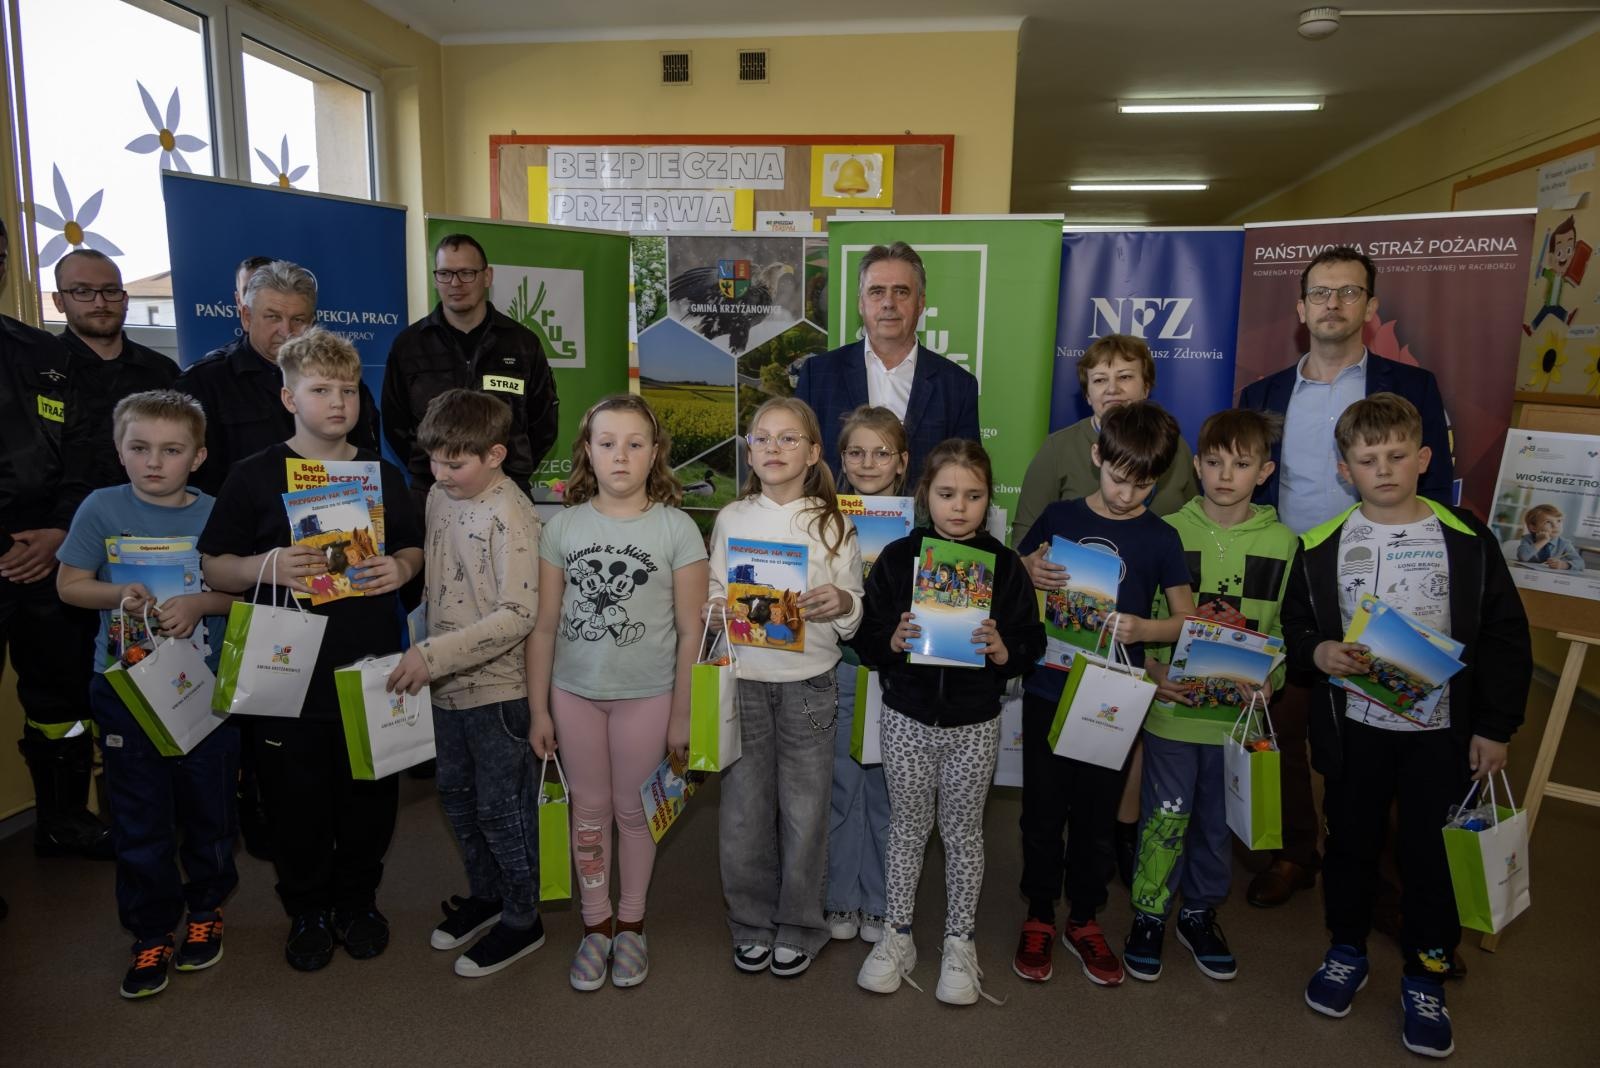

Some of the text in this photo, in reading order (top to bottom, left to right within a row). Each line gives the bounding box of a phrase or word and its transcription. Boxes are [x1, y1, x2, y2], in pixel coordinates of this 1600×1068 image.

[553, 151, 784, 180] BEZPIECZNA
[553, 194, 732, 223] PRZERWA
[1255, 235, 1518, 260] PAŃSTWOA STRAŻ POŻARNA
[195, 300, 399, 325] PAŃST PEKCJA PRACY
[690, 303, 718, 313] GMINA
[1088, 297, 1194, 340] NFZ
[1173, 347, 1223, 360] Zdrowia
[293, 471, 369, 485] bezpieczny
[301, 463, 325, 475] Bądź
[1515, 472, 1554, 484] WIOSKI
[1555, 477, 1575, 486] BEZ
[1576, 479, 1600, 488] TRO
[841, 507, 903, 517] ezpieczny
[565, 542, 659, 574] Minnie & Mickey
[1386, 550, 1444, 561] SURFING
[577, 822, 606, 889] ENJOY
